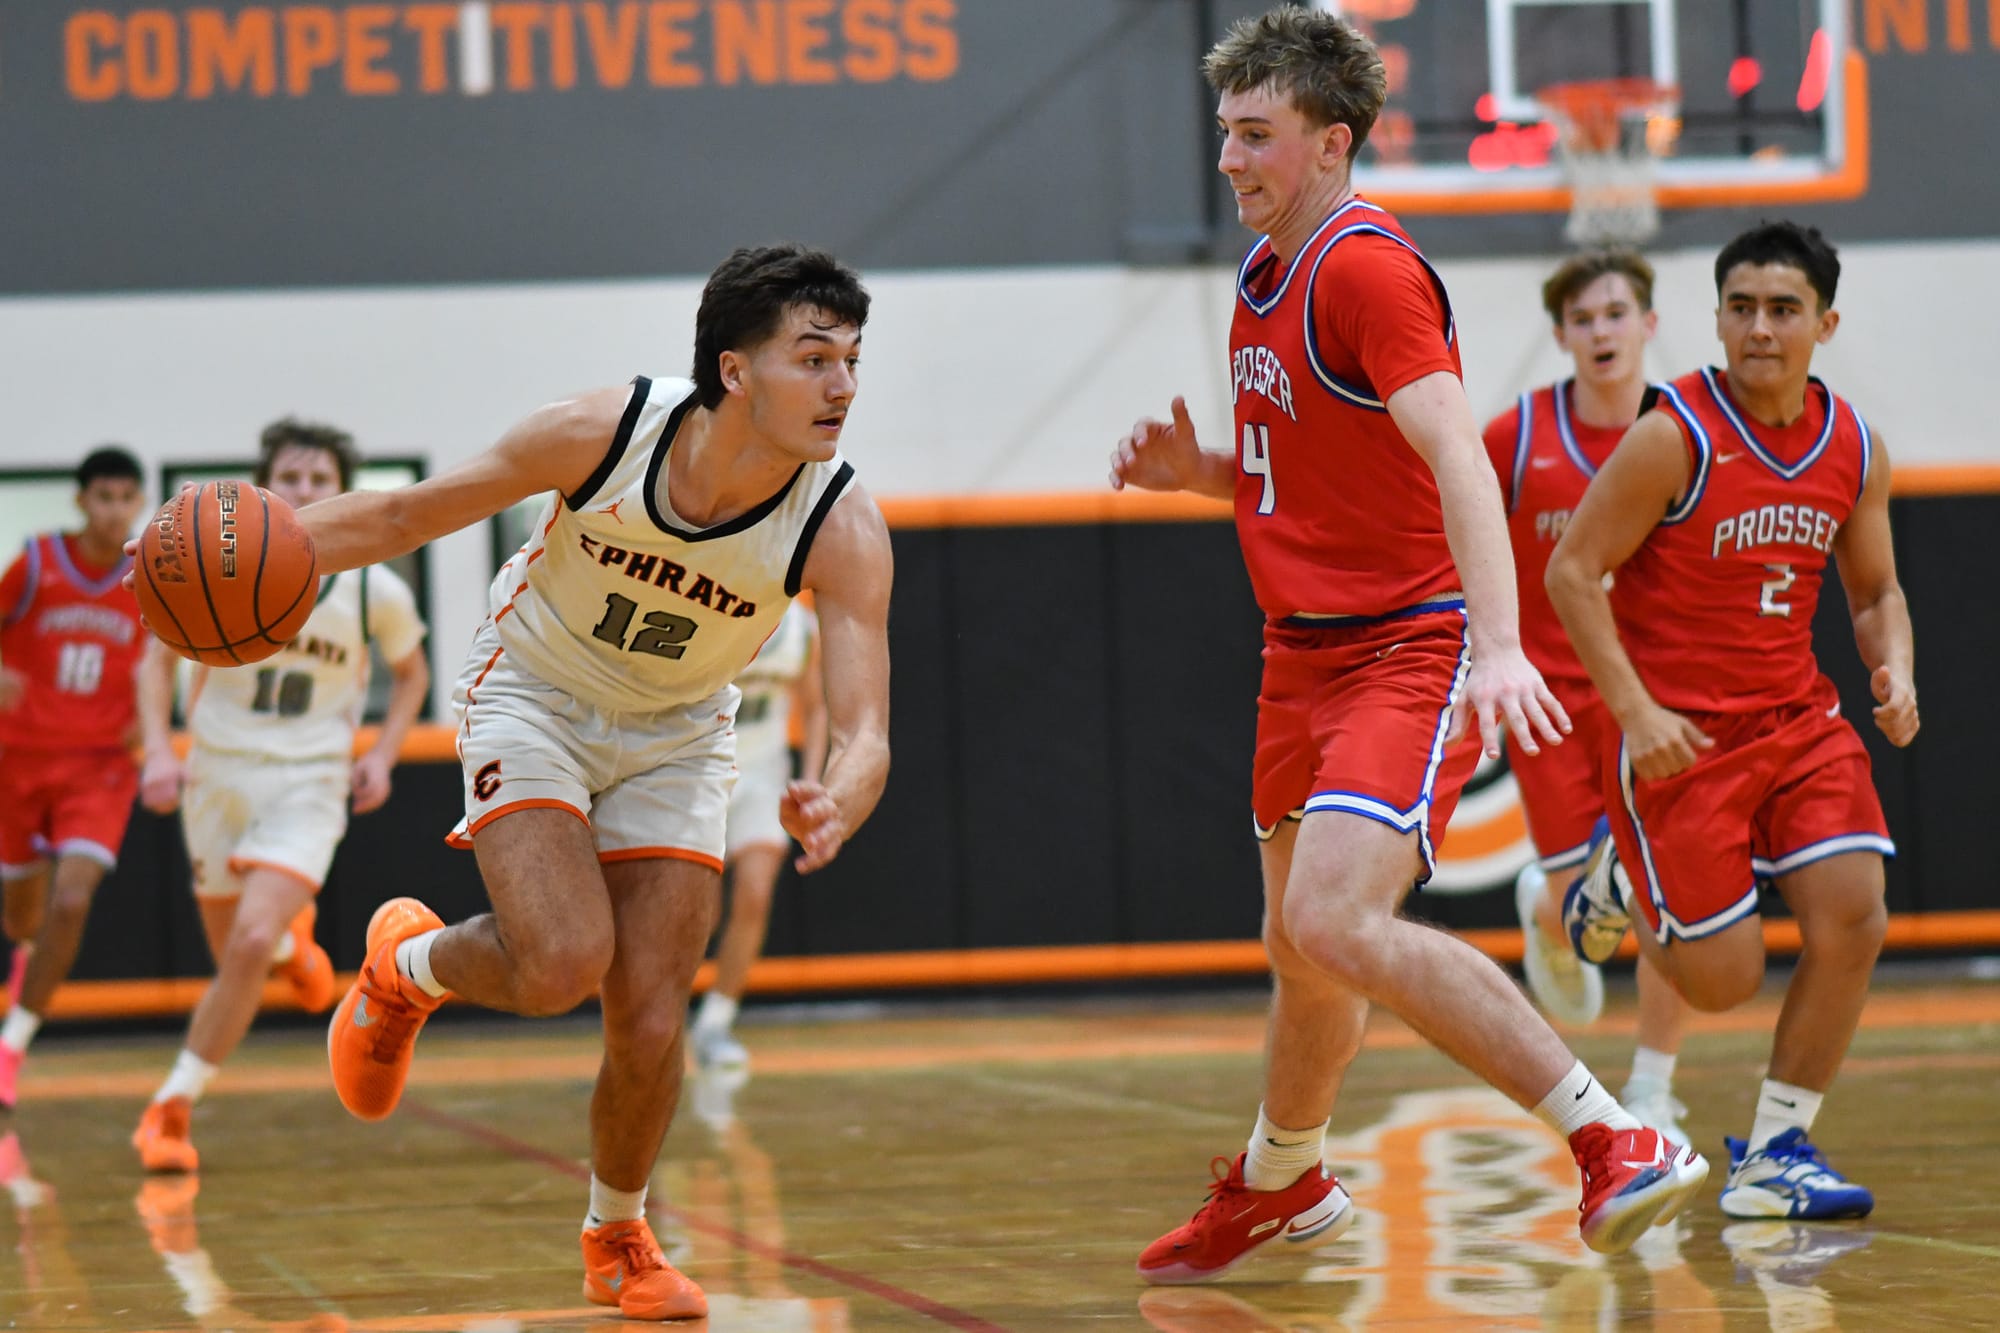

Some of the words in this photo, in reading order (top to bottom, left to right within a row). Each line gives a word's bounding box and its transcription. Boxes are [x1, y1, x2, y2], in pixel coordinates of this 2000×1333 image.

[65, 0, 958, 101] COMPETITIVENESS
[1242, 421, 1277, 516] 4
[1759, 562, 1796, 617] 2
[592, 592, 699, 660] 12
[58, 641, 104, 694] 10
